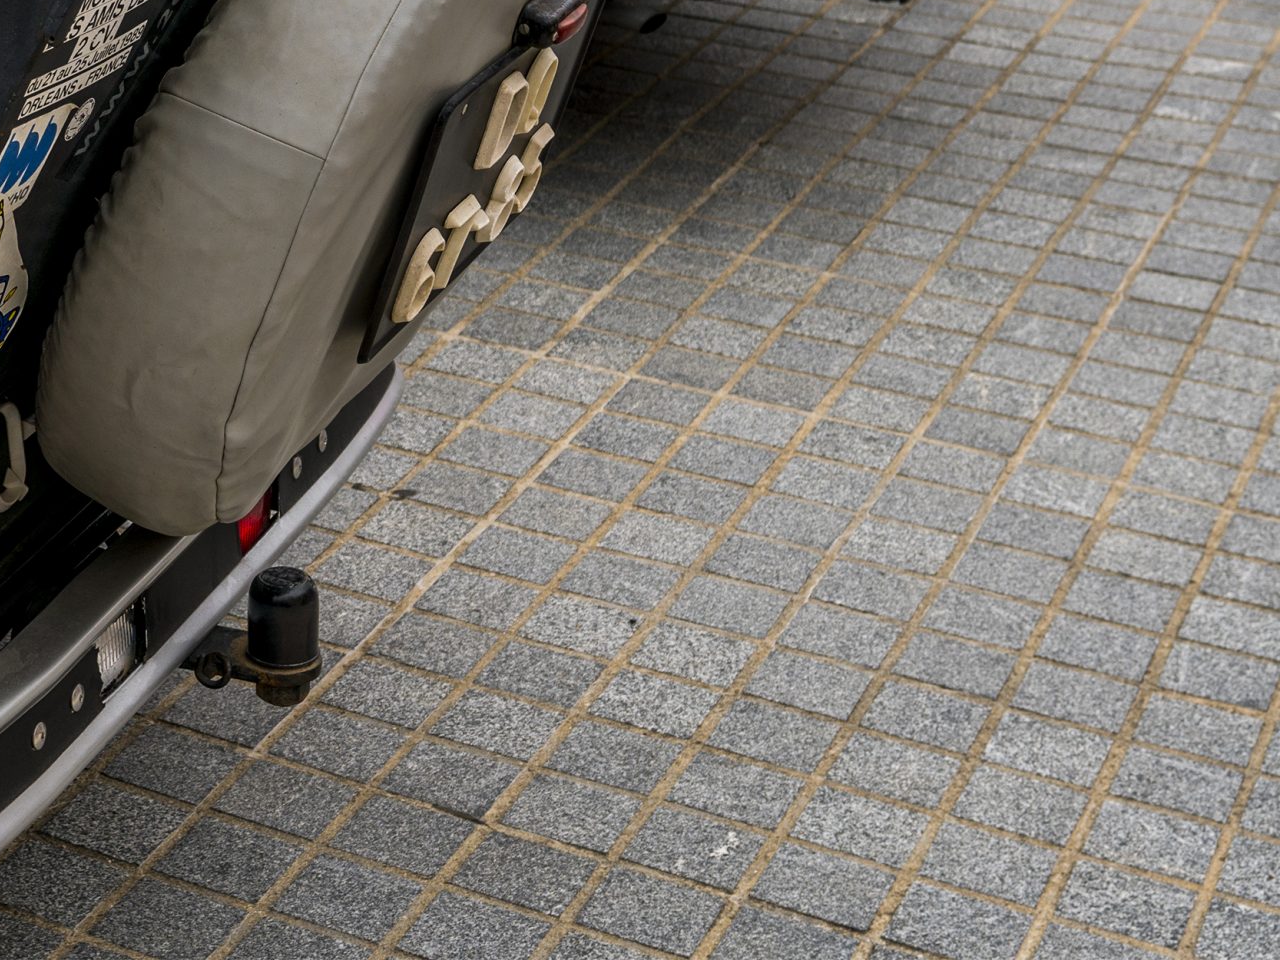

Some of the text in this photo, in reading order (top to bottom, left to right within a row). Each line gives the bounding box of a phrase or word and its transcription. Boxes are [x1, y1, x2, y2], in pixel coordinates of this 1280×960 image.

[72, 36, 88, 60] 2
[26, 78, 43, 94] du
[42, 70, 58, 87] 21
[56, 65, 73, 81] au
[71, 55, 90, 74] 25
[84, 51, 130, 86] FRANCE
